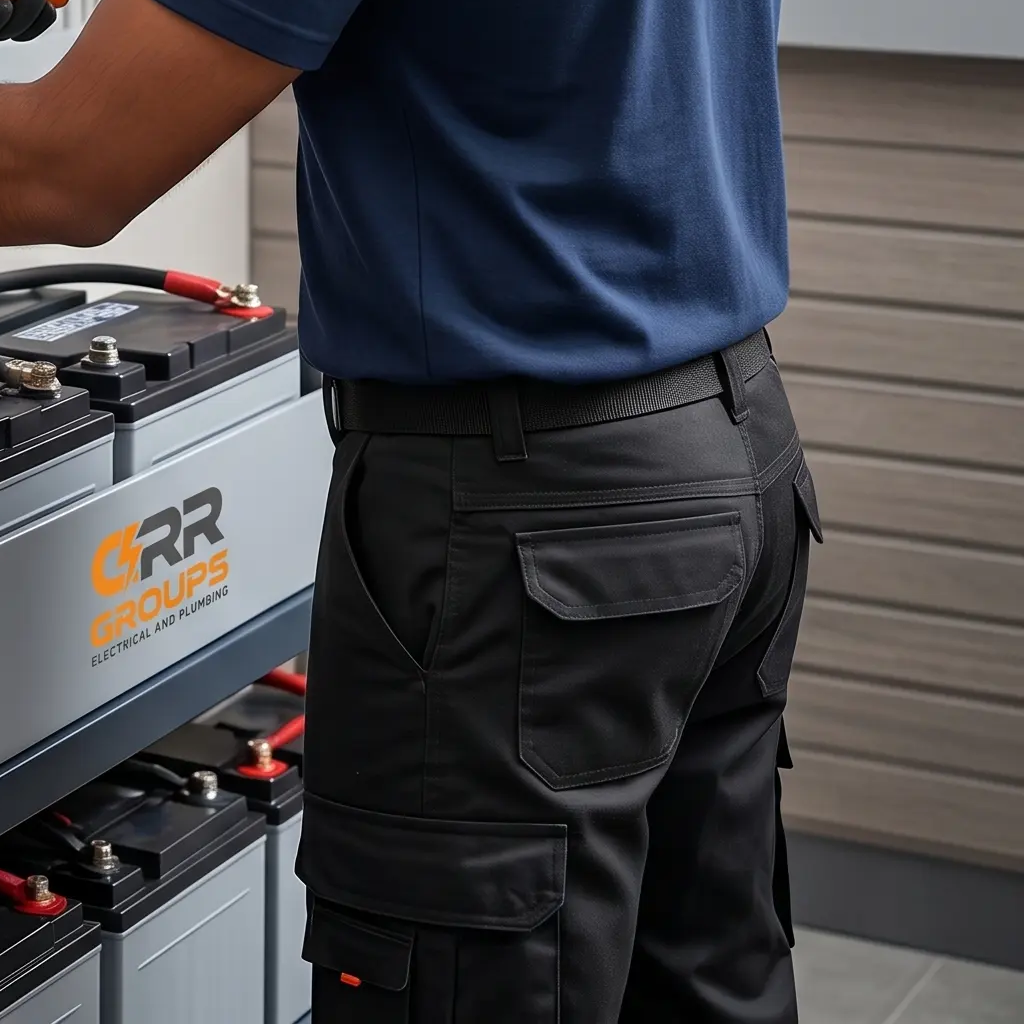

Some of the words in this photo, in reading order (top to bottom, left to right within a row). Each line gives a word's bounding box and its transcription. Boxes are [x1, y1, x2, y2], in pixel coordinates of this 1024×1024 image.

[91, 487, 225, 597] CRR
[90, 548, 229, 647] GROUPS
[91, 627, 151, 667] ELECTRICAL
[154, 614, 175, 634] AND
[179, 585, 229, 621] PLUMBING
